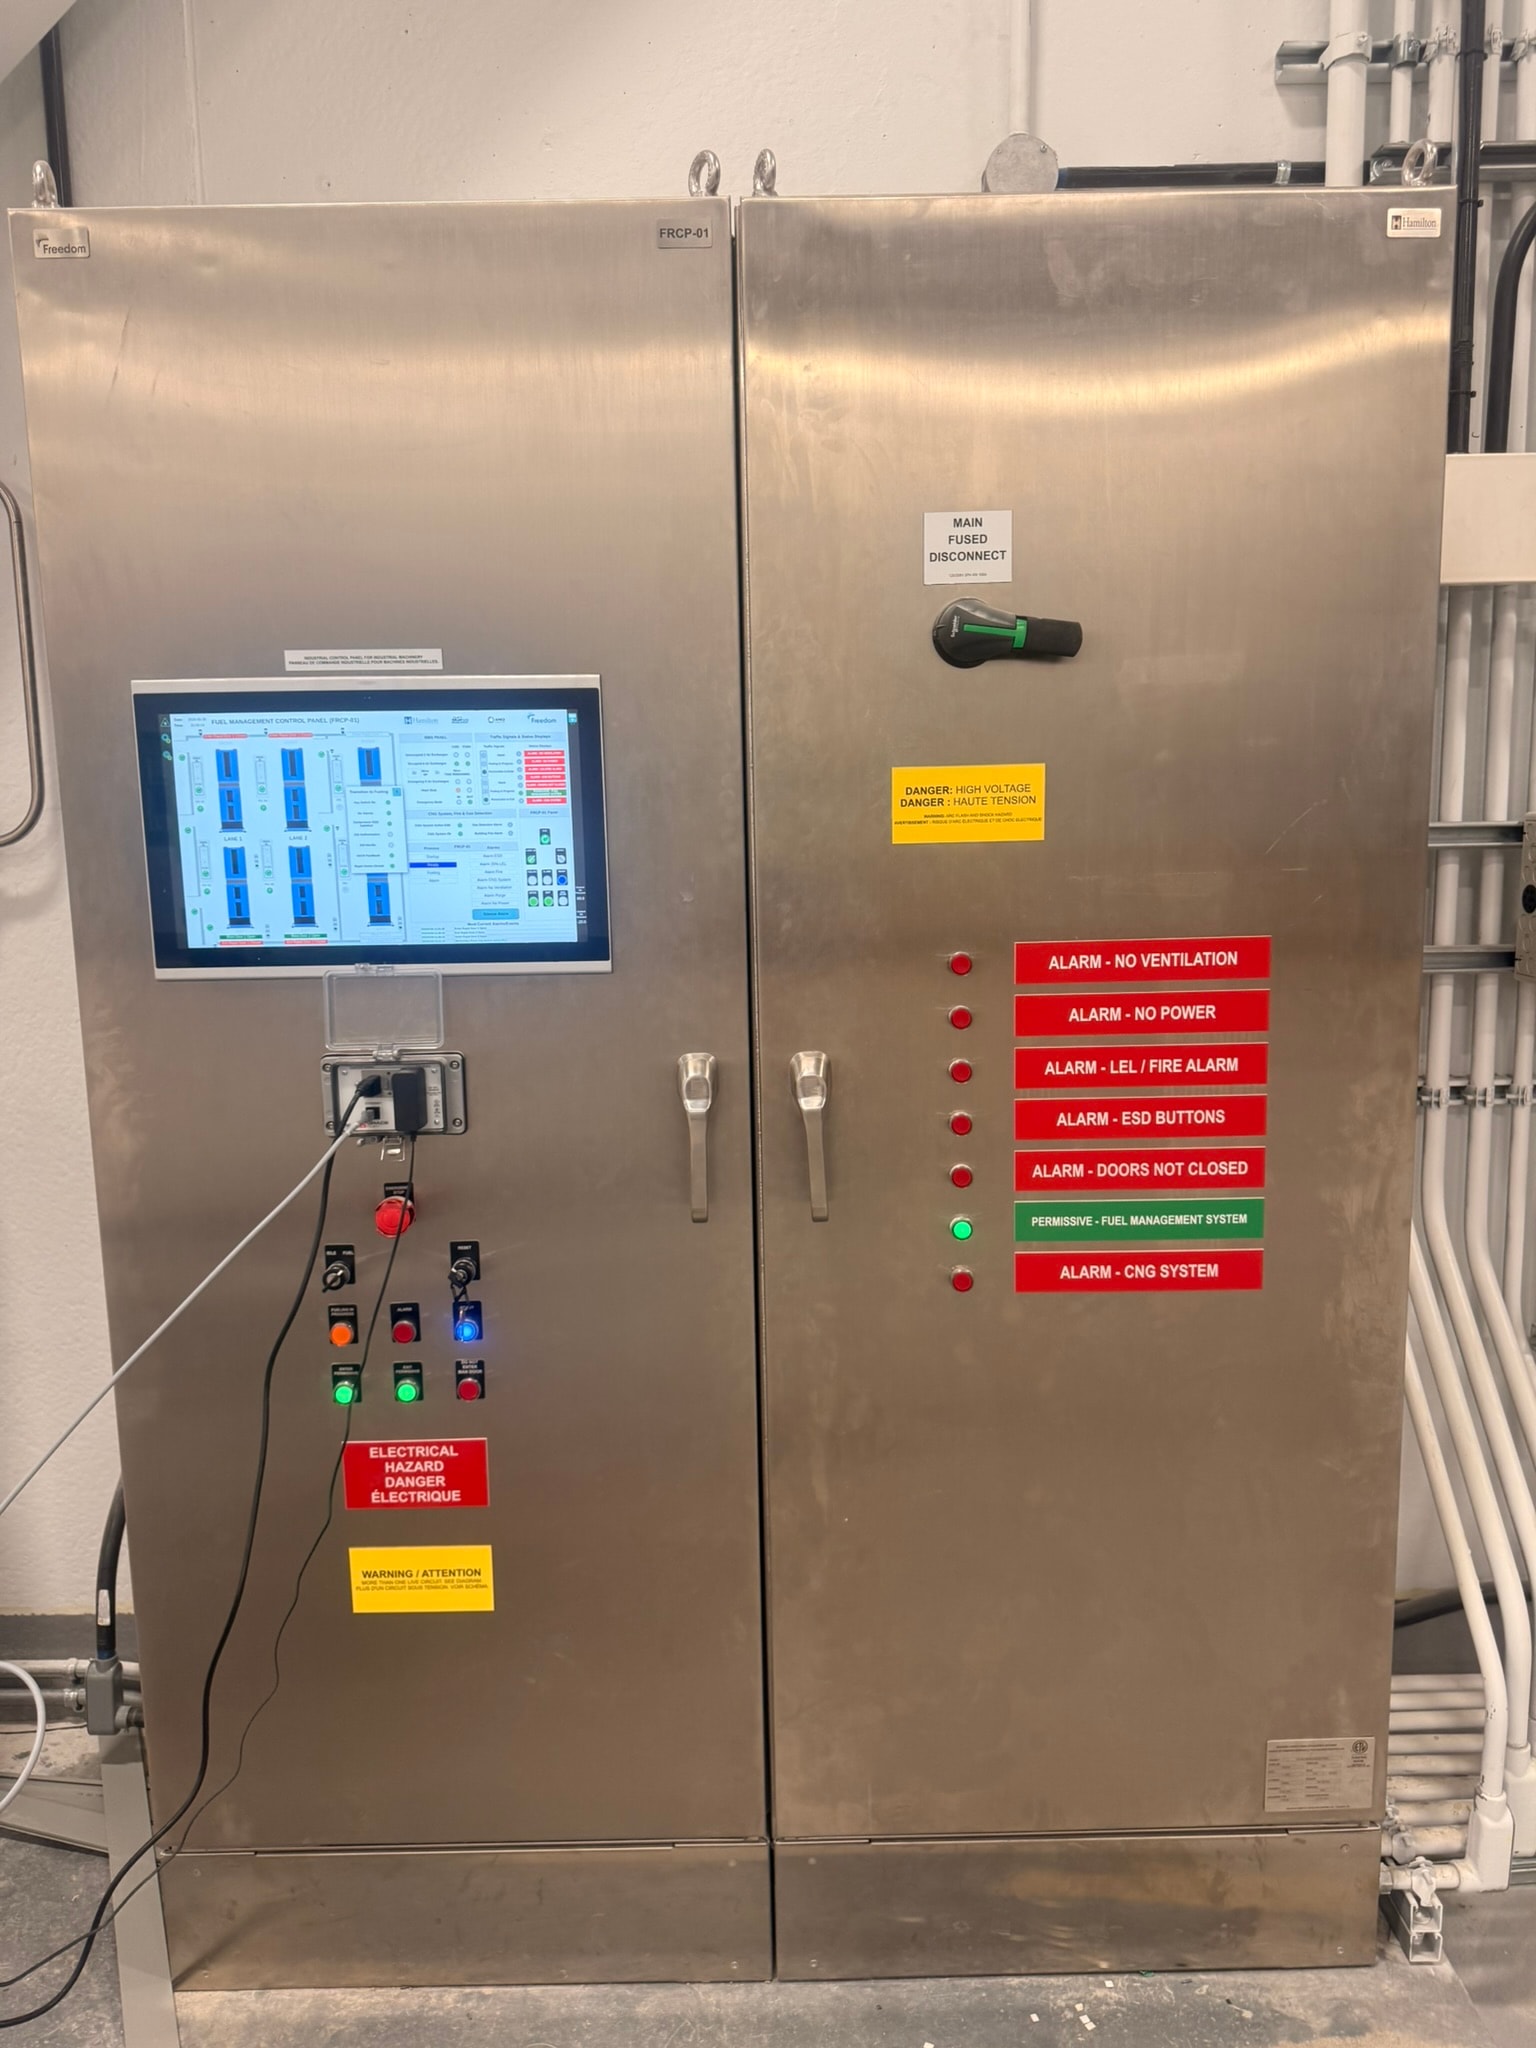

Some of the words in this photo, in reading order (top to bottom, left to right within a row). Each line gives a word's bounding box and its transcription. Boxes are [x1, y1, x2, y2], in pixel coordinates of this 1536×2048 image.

[1403, 217, 1436, 228] Hamilton
[660, 228, 708, 238] FRCP-01
[43, 244, 86, 254] Freedom
[953, 517, 983, 528] MAIN
[948, 534, 987, 545] FUSED
[930, 550, 1007, 562] DISCONNECT
[906, 786, 953, 795] DANGER:
[956, 785, 981, 794] HIGH
[984, 783, 1031, 793] VOLTAGE
[900, 797, 944, 807] DANGER
[954, 796, 987, 806] HAUTE
[990, 795, 1036, 805] TENSION
[1048, 953, 1102, 970] ALARM
[1115, 953, 1137, 969] NO
[1140, 950, 1238, 968] VENTILATION
[1068, 1006, 1122, 1022] ALARM
[1134, 1006, 1157, 1021] NO
[1160, 1005, 1216, 1021] POWER
[1044, 1060, 1097, 1076] ALARM
[1110, 1060, 1138, 1074] LEL
[1140, 1059, 1146, 1074] /
[1149, 1058, 1183, 1074] FIRE
[1185, 1057, 1239, 1073] ALARM
[1056, 1111, 1109, 1127] ALARM
[1121, 1110, 1152, 1126] ESD
[1155, 1109, 1225, 1125] BUTTONS
[1032, 1163, 1084, 1179] ALARM
[1097, 1162, 1150, 1177] DOORS
[1153, 1161, 1184, 1176] NOT
[1188, 1161, 1248, 1176] CLOSED
[1031, 1216, 1093, 1227] PERMISSIVE
[1101, 1215, 1128, 1226] FUEL
[1130, 1215, 1203, 1226] MANAGEMENT
[1205, 1214, 1248, 1225] SYSTEM
[1060, 1265, 1112, 1280] ALARM
[1124, 1264, 1156, 1279] CNG
[1160, 1263, 1219, 1279] SYSTEM
[369, 1445, 458, 1458] ELECTRICAL
[385, 1461, 444, 1473] HAZARD
[385, 1476, 446, 1488] DANGER
[371, 1489, 461, 1503] ÉLECTRIQUE
[362, 1570, 413, 1578] WARNING
[422, 1568, 481, 1577] ATTENTION
